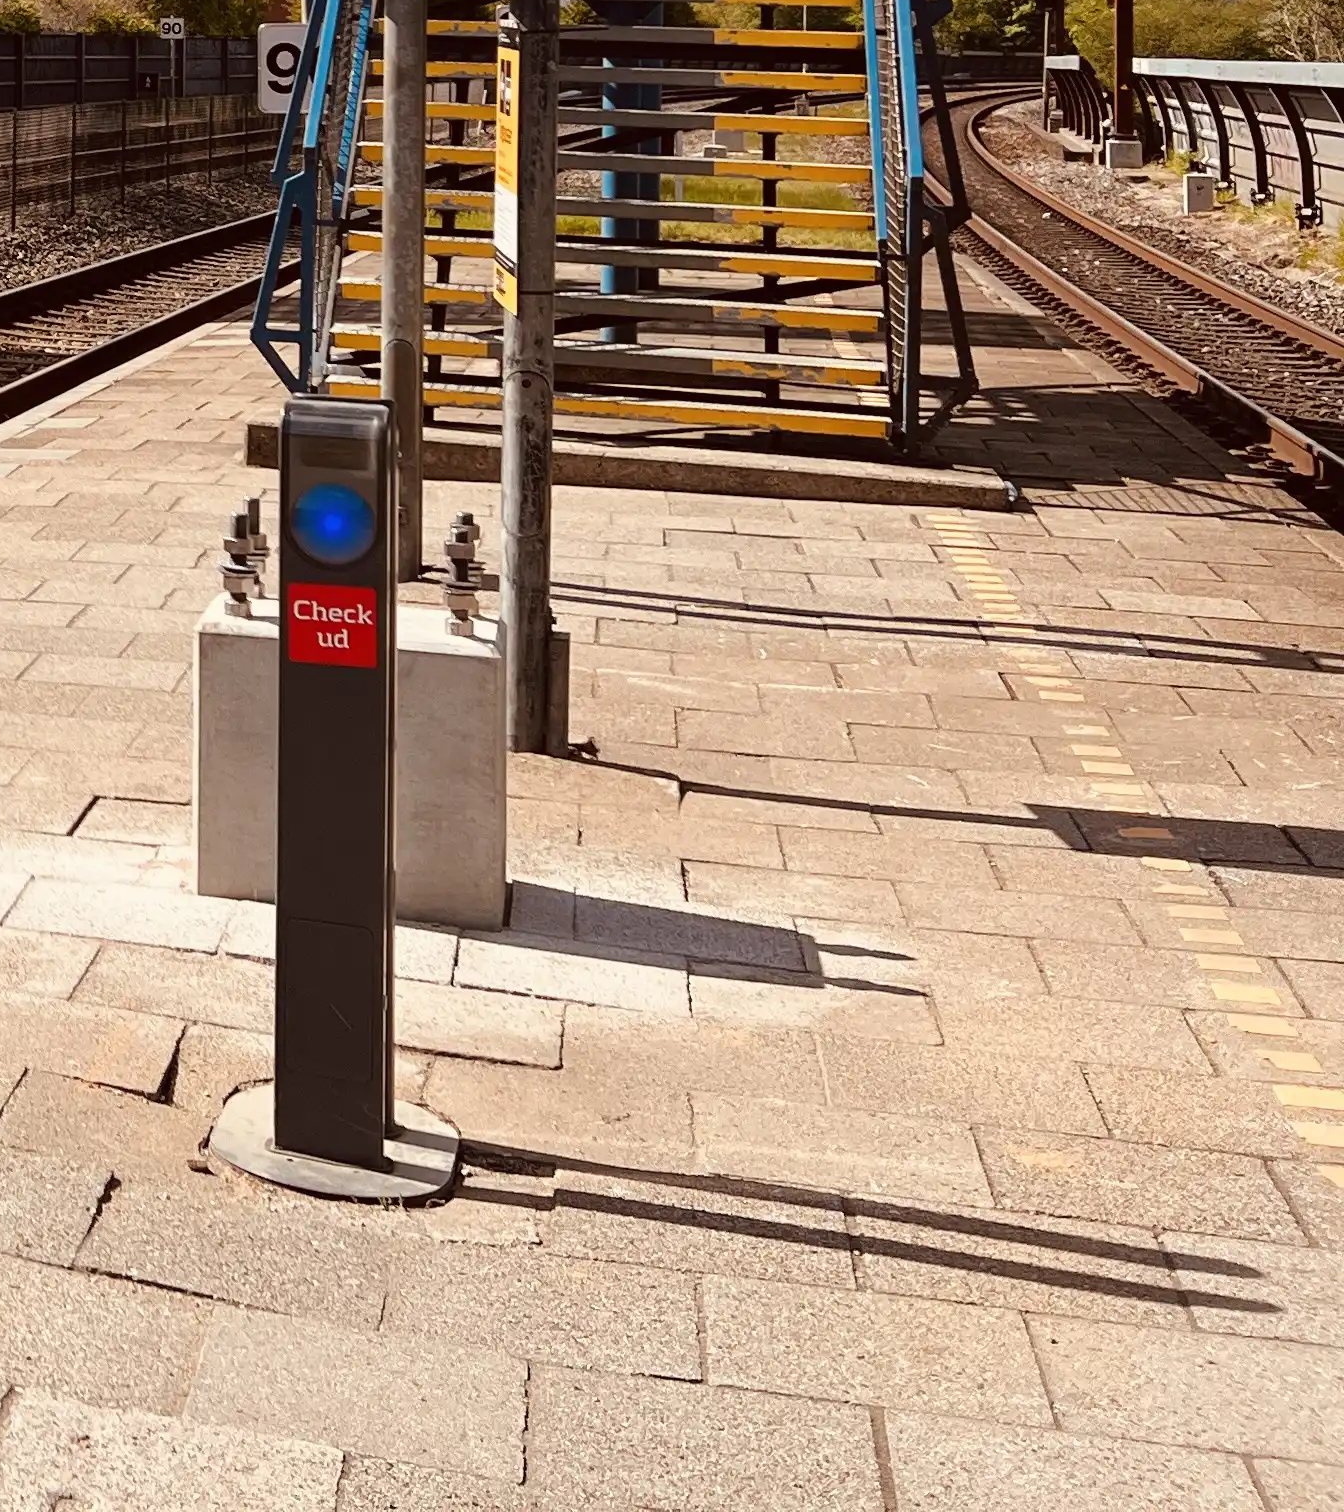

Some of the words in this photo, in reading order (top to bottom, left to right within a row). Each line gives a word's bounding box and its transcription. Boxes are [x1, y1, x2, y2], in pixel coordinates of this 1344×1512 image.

[161, 22, 182, 35] 90
[266, 42, 316, 94] 9
[293, 599, 374, 625] Check
[316, 628, 350, 649] ud
